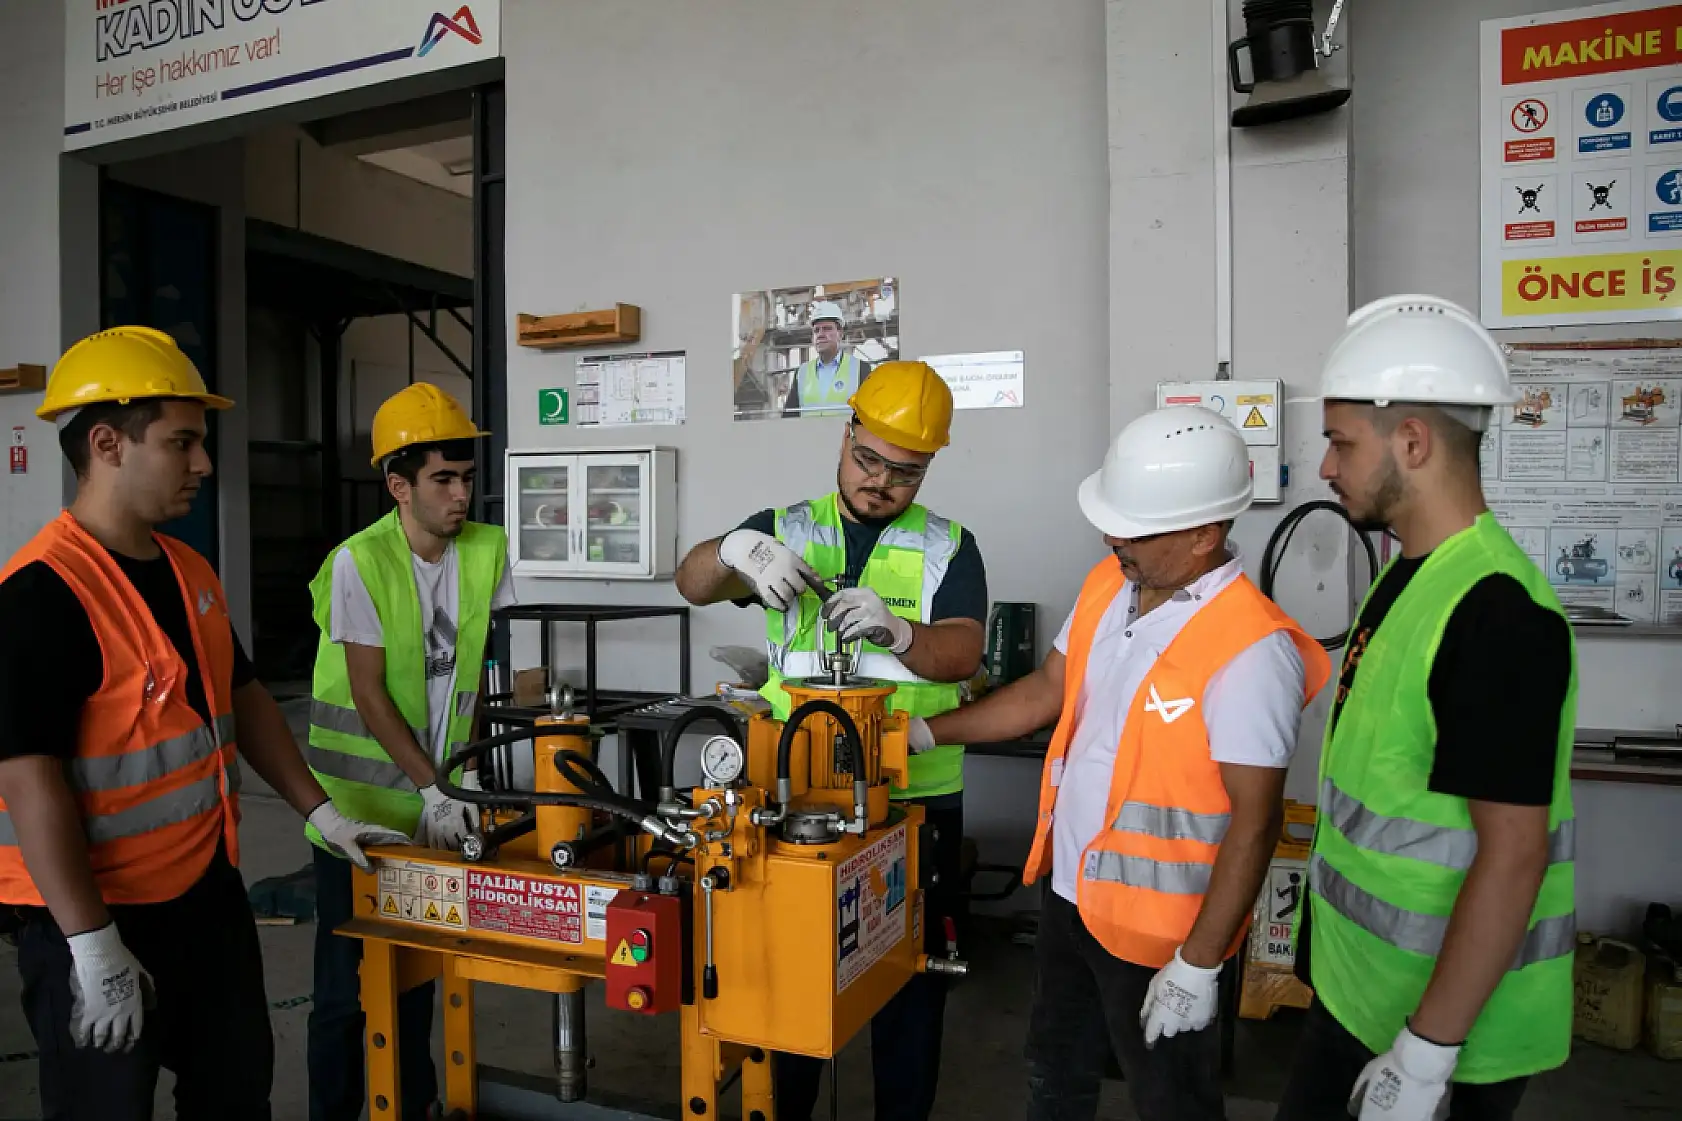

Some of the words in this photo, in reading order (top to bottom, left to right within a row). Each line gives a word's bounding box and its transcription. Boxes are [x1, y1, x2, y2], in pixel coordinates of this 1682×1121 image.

[96, 0, 225, 62] KADIN
[1522, 28, 1662, 71] MAKİNE
[96, 71, 127, 99] Her
[131, 65, 156, 97] işe
[159, 45, 241, 84] hakkımız
[244, 27, 281, 62] var!
[1517, 265, 1627, 302] ÖNCE
[1642, 257, 1677, 301] İŞ
[468, 885, 578, 913] HİDROLİKSAN
[469, 872, 526, 892] HALİM
[530, 881, 578, 898] USTA
